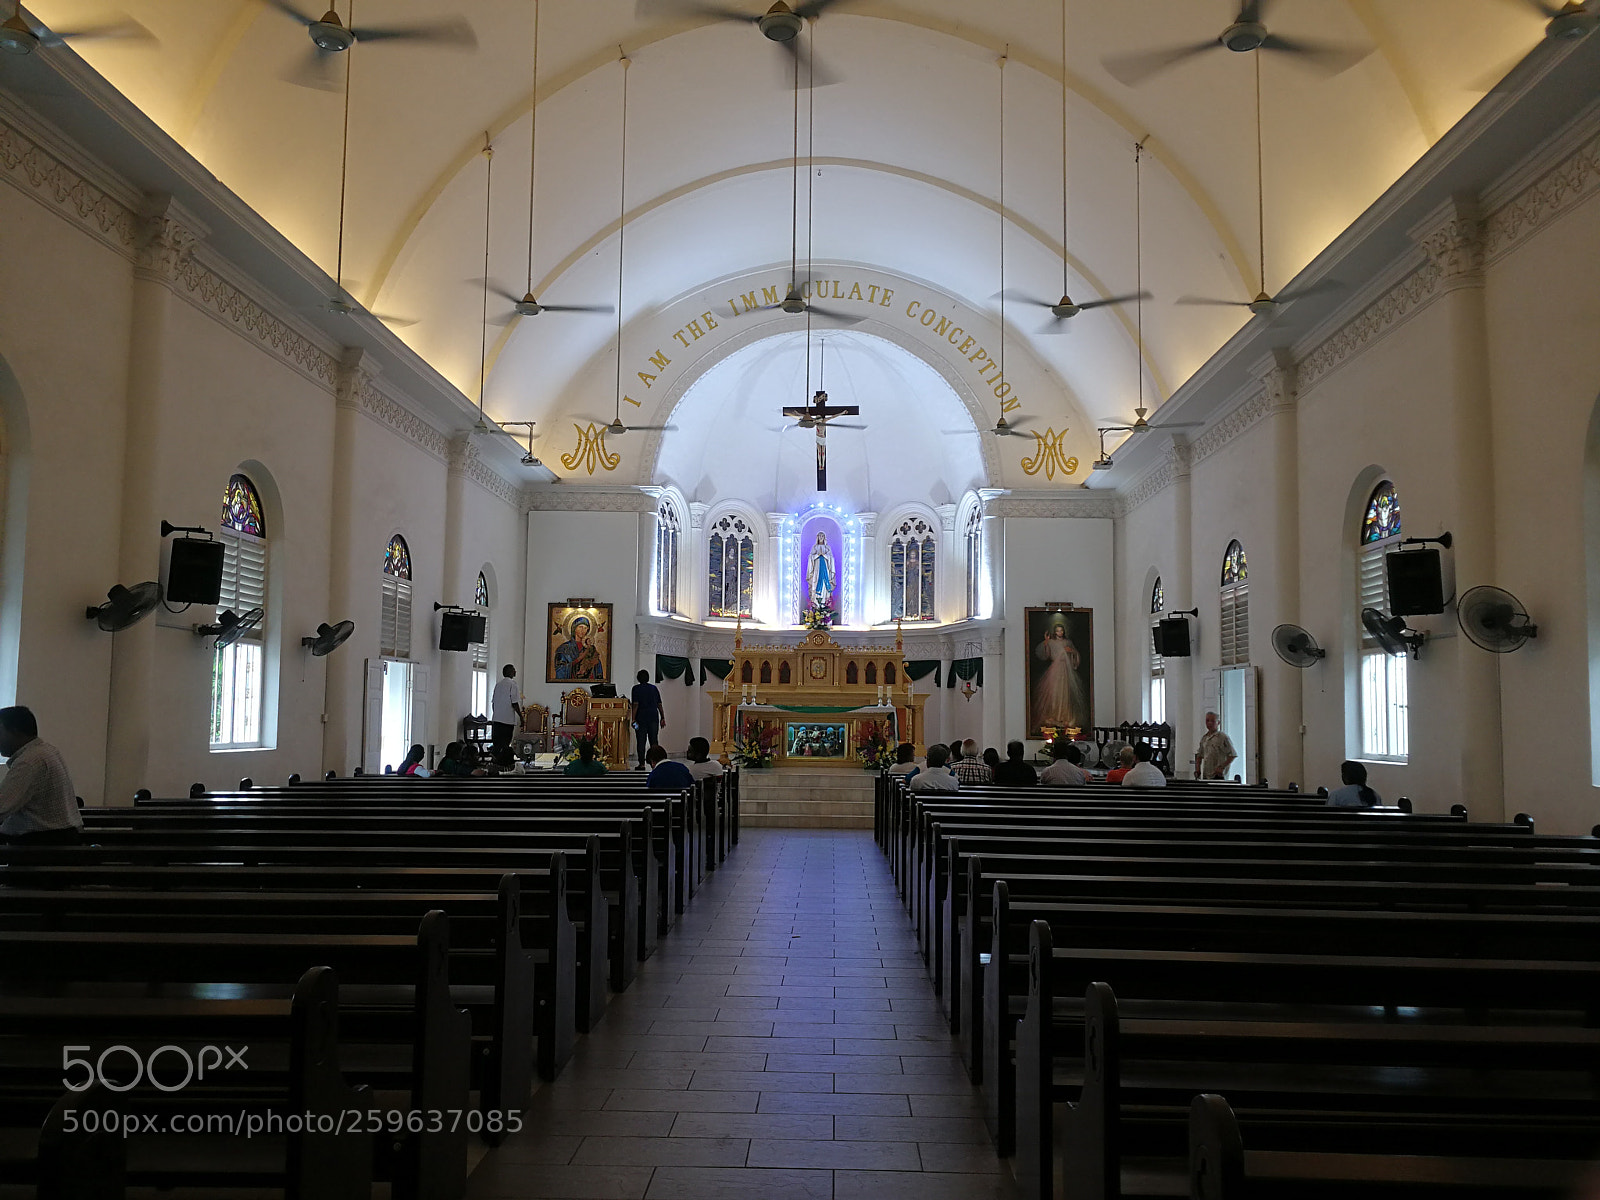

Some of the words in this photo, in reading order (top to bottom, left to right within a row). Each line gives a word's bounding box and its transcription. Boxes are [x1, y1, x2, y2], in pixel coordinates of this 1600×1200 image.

[623, 394, 642, 409] I
[637, 350, 672, 389] AM
[672, 310, 719, 348] THE
[727, 279, 896, 316] IMMACULATE
[906, 300, 1022, 415] CONCEPTION
